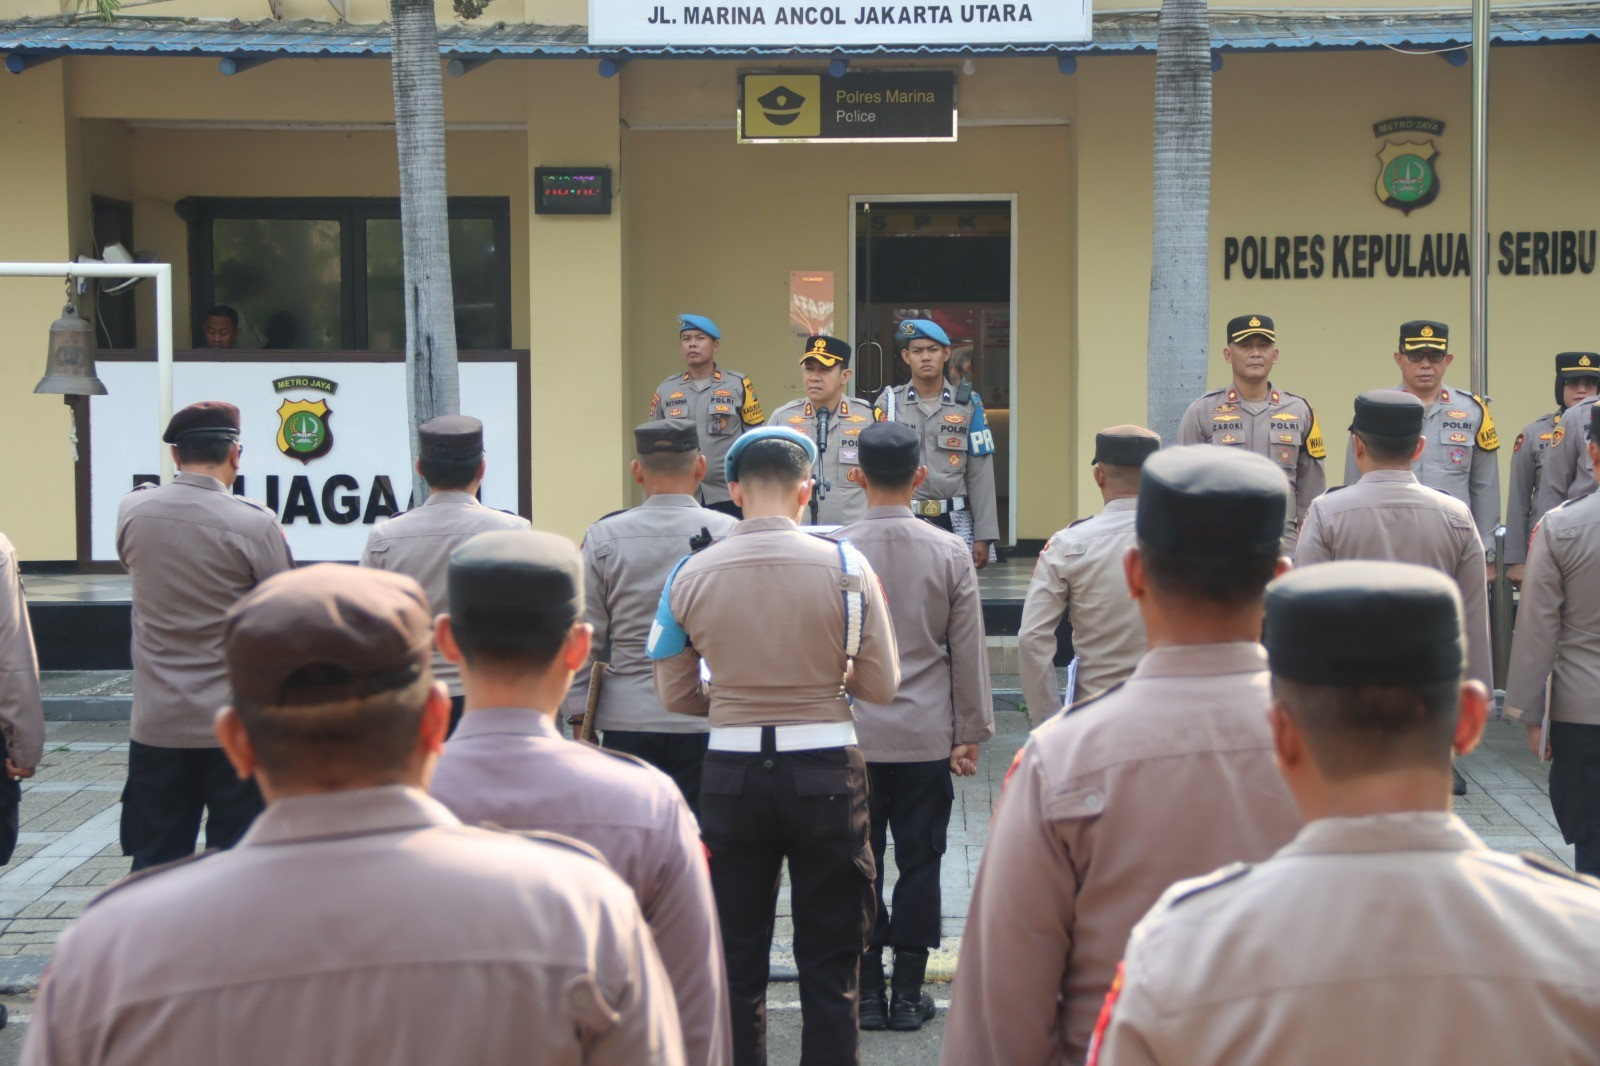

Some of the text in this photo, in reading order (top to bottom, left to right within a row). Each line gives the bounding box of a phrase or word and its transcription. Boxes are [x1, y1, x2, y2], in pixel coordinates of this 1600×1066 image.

[647, 4, 1033, 25] JL. MARINA ANCOL JAKARTA UTARA
[836, 89, 935, 104] Polres Marina
[836, 110, 876, 122] Police
[1379, 120, 1439, 132] METRO JAYA
[1224, 230, 1597, 280] POLRES KEPULAUA SERIBU
[277, 379, 331, 391] METRO JAYA
[711, 397, 734, 405] POLRI
[940, 424, 967, 434] POLRI
[1212, 422, 1243, 432] ZAROKI
[1270, 422, 1299, 430] POLRI
[1442, 421, 1472, 430] POLRI
[841, 439, 859, 447] POL
